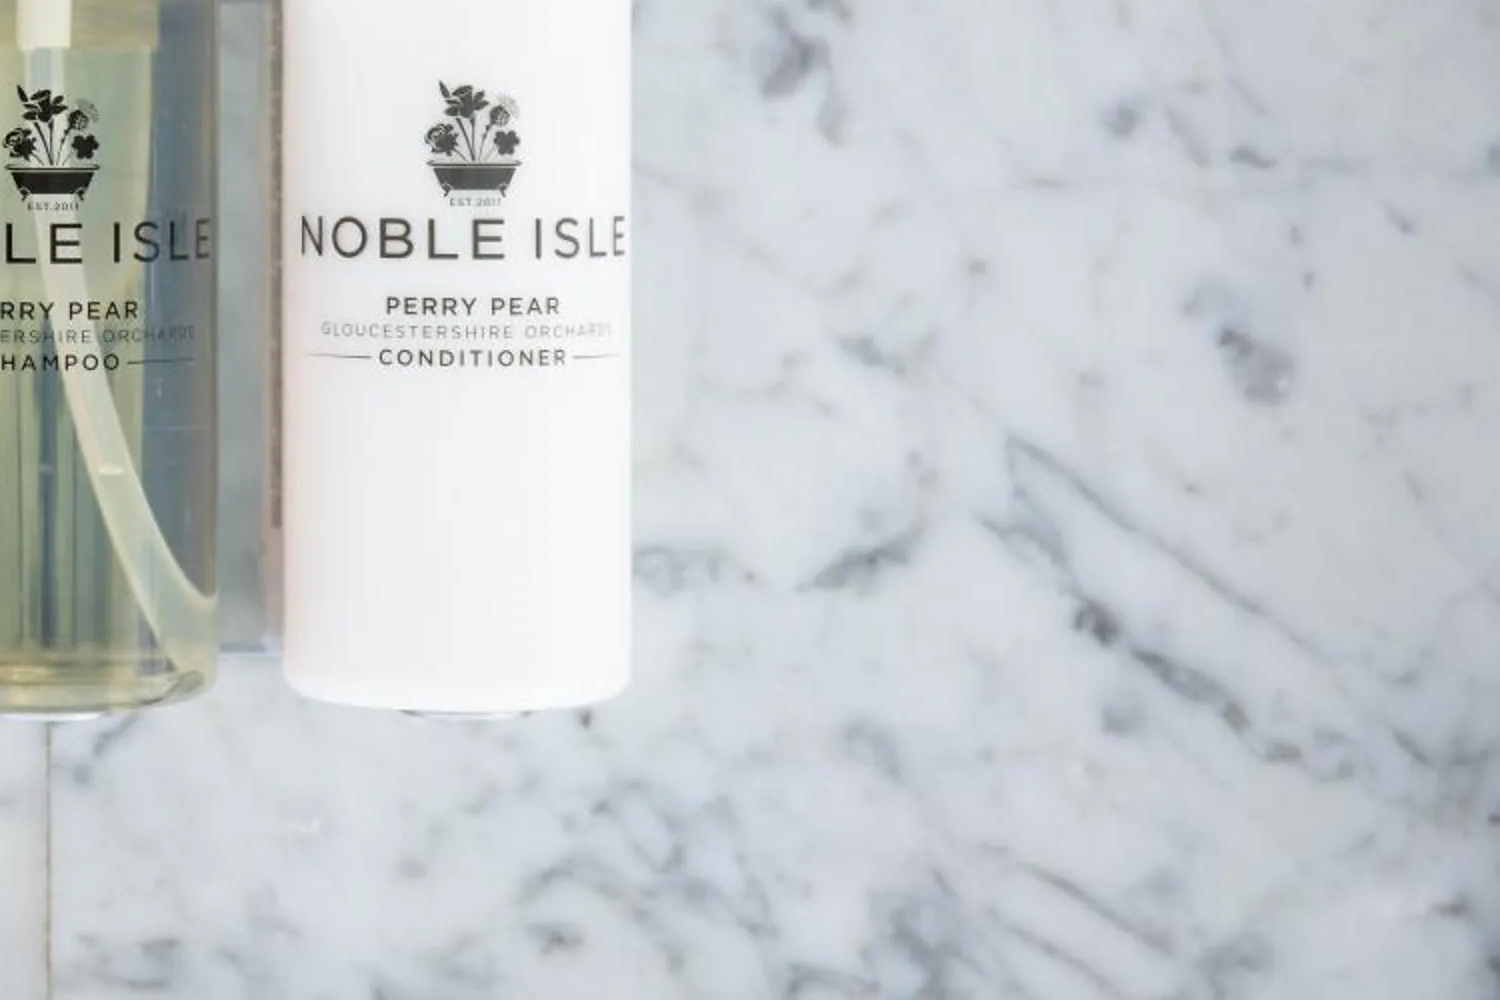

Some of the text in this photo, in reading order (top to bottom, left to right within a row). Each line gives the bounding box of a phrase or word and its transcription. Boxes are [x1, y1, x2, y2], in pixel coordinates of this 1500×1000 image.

[113, 218, 212, 264] ISLE
[301, 215, 626, 260] NOBLE ISLE
[69, 301, 139, 320] PEAR
[386, 297, 560, 316] PERRY PEAR
[321, 322, 514, 340] GLOUCESTERSHIRE
[379, 349, 566, 368] CONDITIONER
